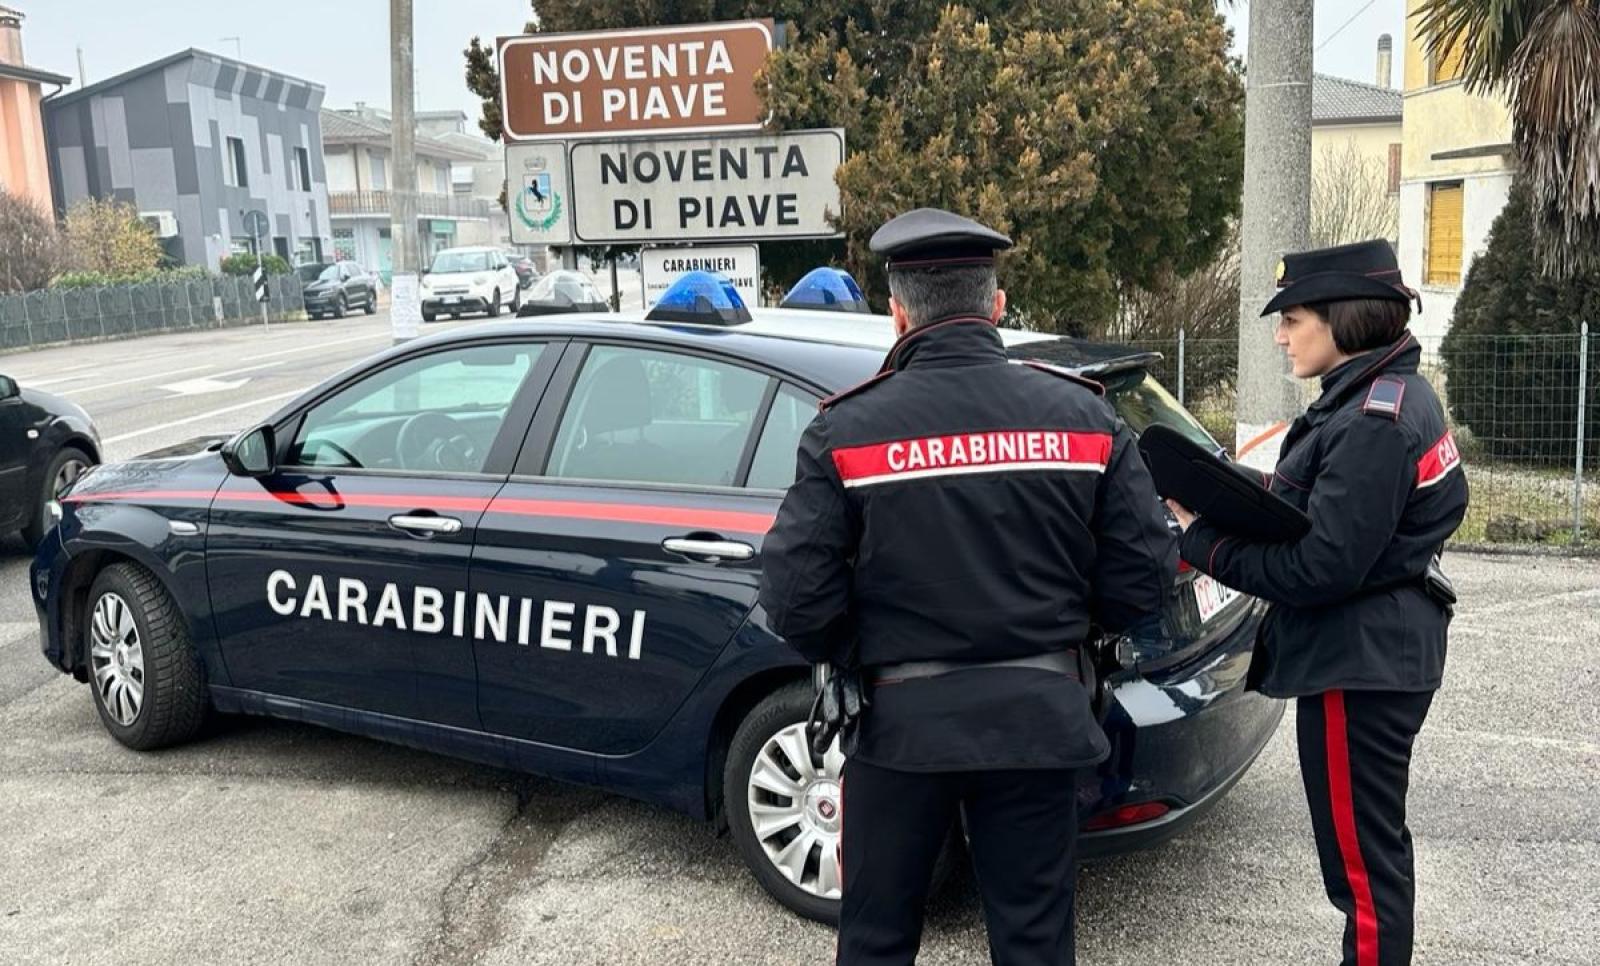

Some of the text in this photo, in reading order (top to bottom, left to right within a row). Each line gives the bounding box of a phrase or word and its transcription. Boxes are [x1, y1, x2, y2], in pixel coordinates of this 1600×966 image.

[533, 40, 733, 84] NOVENTA
[543, 83, 727, 125] DI PIAVE
[600, 145, 809, 184] NOVENTA
[614, 194, 799, 230] DI PIAVE
[663, 257, 736, 272] CARABINIERI
[887, 432, 1070, 472] CARABINIERI
[267, 569, 646, 660] CARABINIERI
